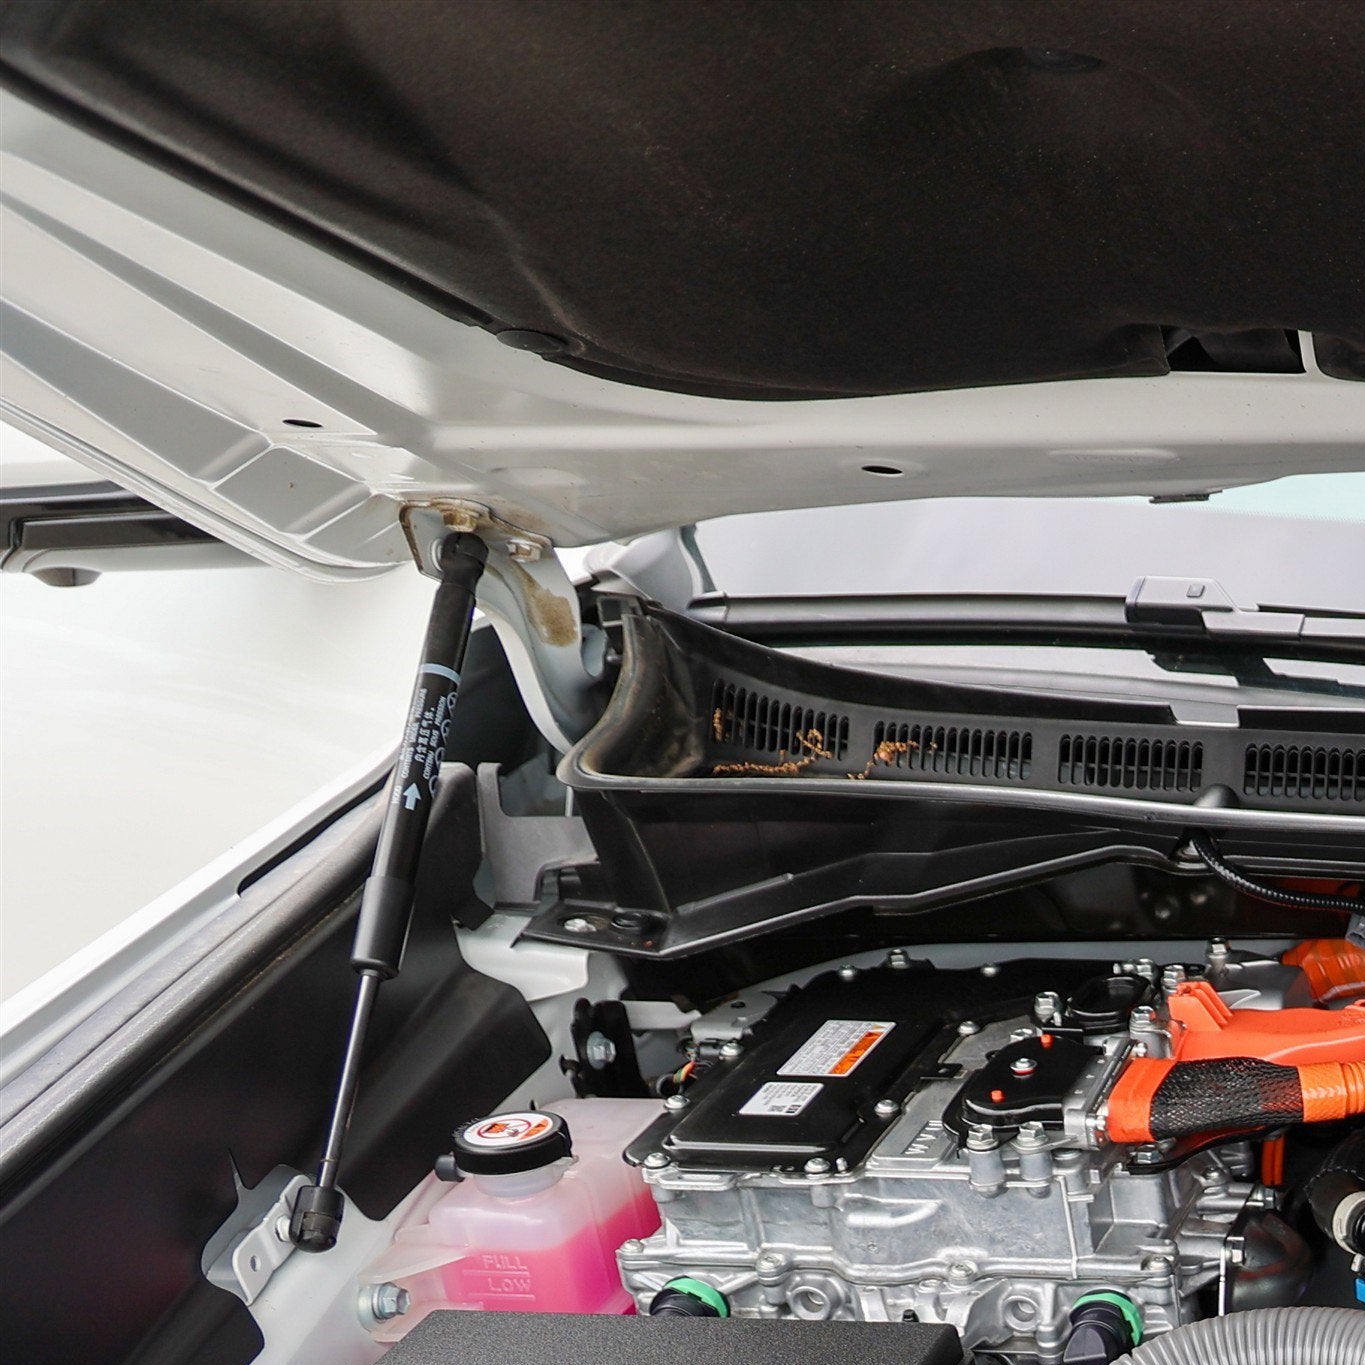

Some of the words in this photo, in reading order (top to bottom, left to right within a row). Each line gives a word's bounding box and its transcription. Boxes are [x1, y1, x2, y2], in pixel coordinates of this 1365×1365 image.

[422, 750, 434, 779] CONTENU
[429, 730, 439, 747] SOUS
[481, 1254, 528, 1270] FULL
[487, 1278, 530, 1292] LOW
